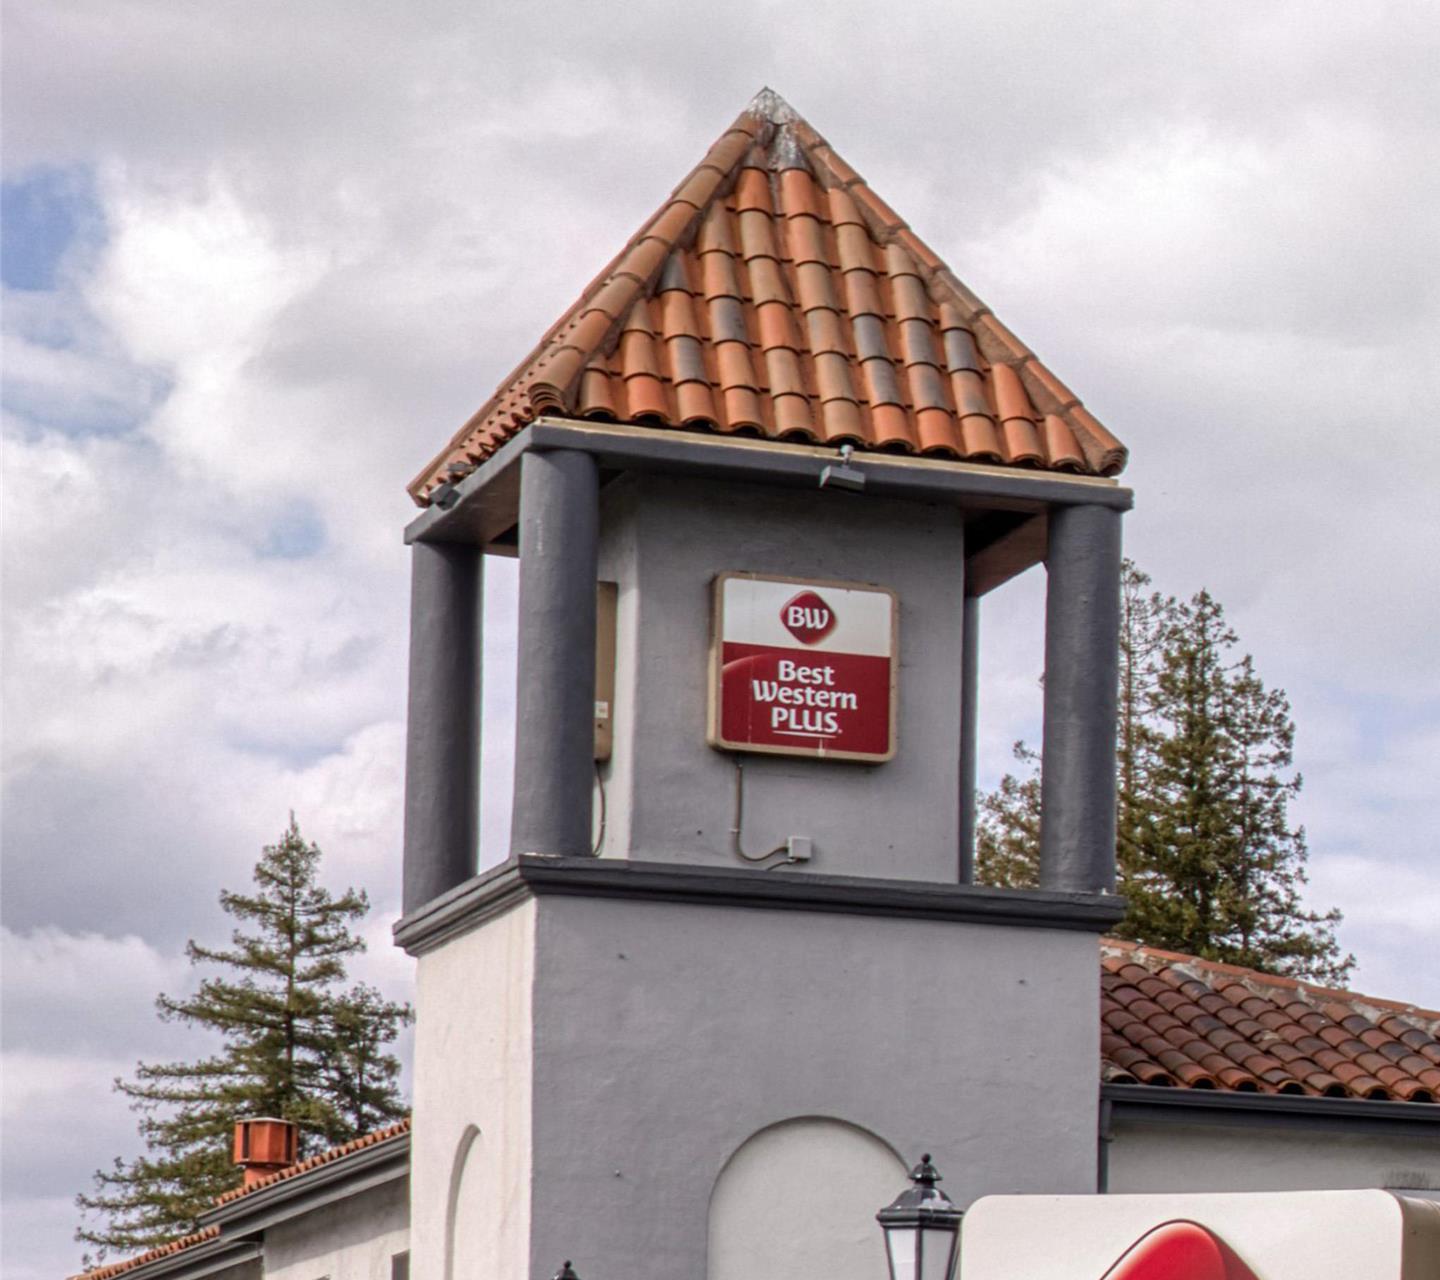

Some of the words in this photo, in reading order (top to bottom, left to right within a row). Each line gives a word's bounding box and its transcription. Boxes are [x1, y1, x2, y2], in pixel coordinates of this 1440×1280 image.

[787, 606, 829, 629] BW
[778, 660, 835, 686] Best
[752, 679, 858, 710] Western
[771, 706, 838, 733] PLUS
